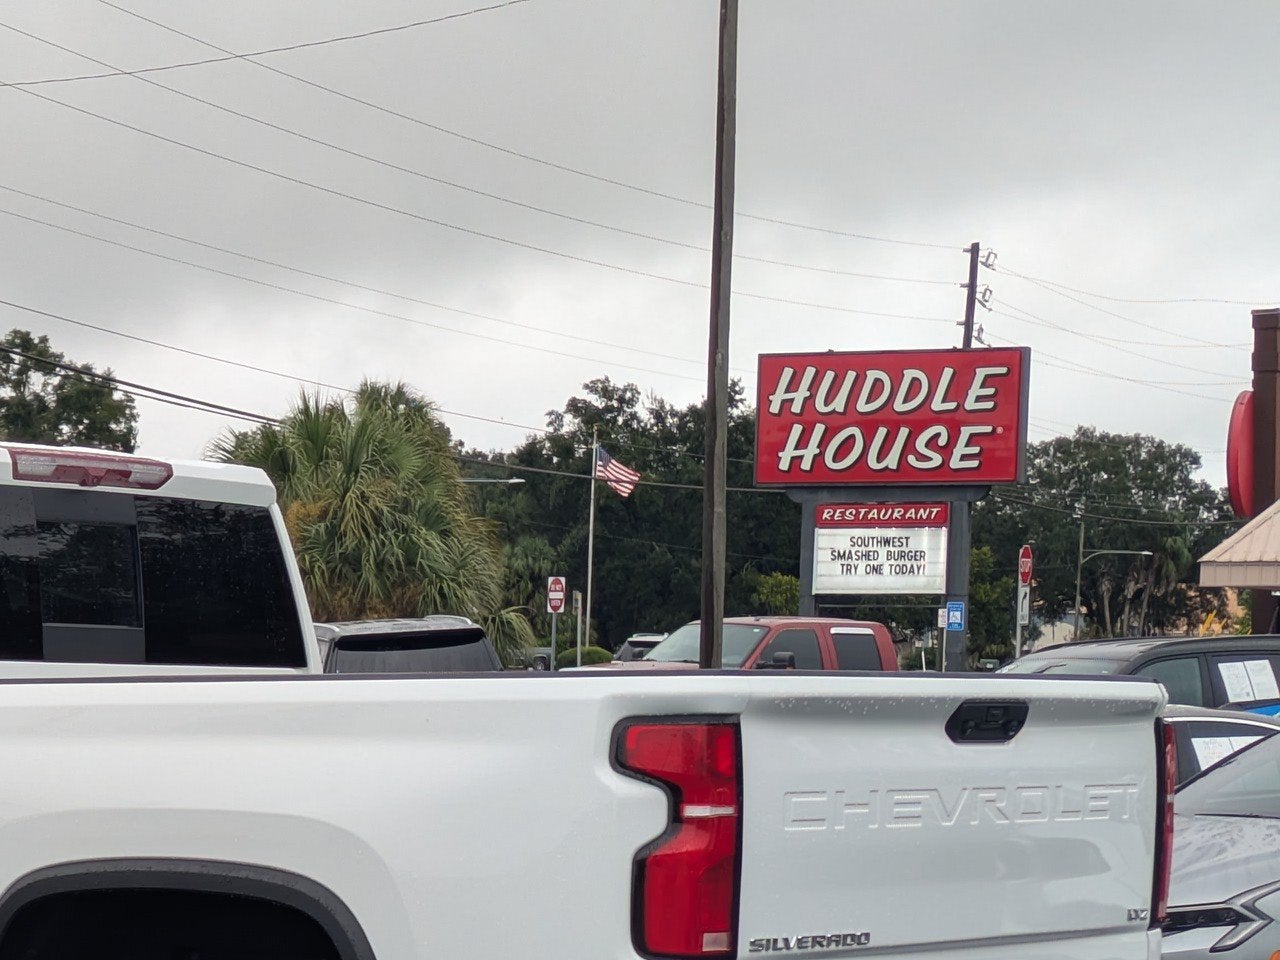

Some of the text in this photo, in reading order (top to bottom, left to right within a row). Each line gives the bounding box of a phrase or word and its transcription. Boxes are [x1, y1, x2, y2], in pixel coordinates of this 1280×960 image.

[768, 365, 1009, 415] HUDDLE
[778, 422, 995, 472] HOUSE
[822, 507, 942, 520] RESTAURANT
[849, 536, 911, 548] SOUTHWEST
[830, 549, 926, 561] SMASHED BURGER
[840, 563, 926, 575] TRY ONE TODAY!
[783, 783, 1139, 832] CHEVROLET
[748, 932, 871, 953] SILVERADO
